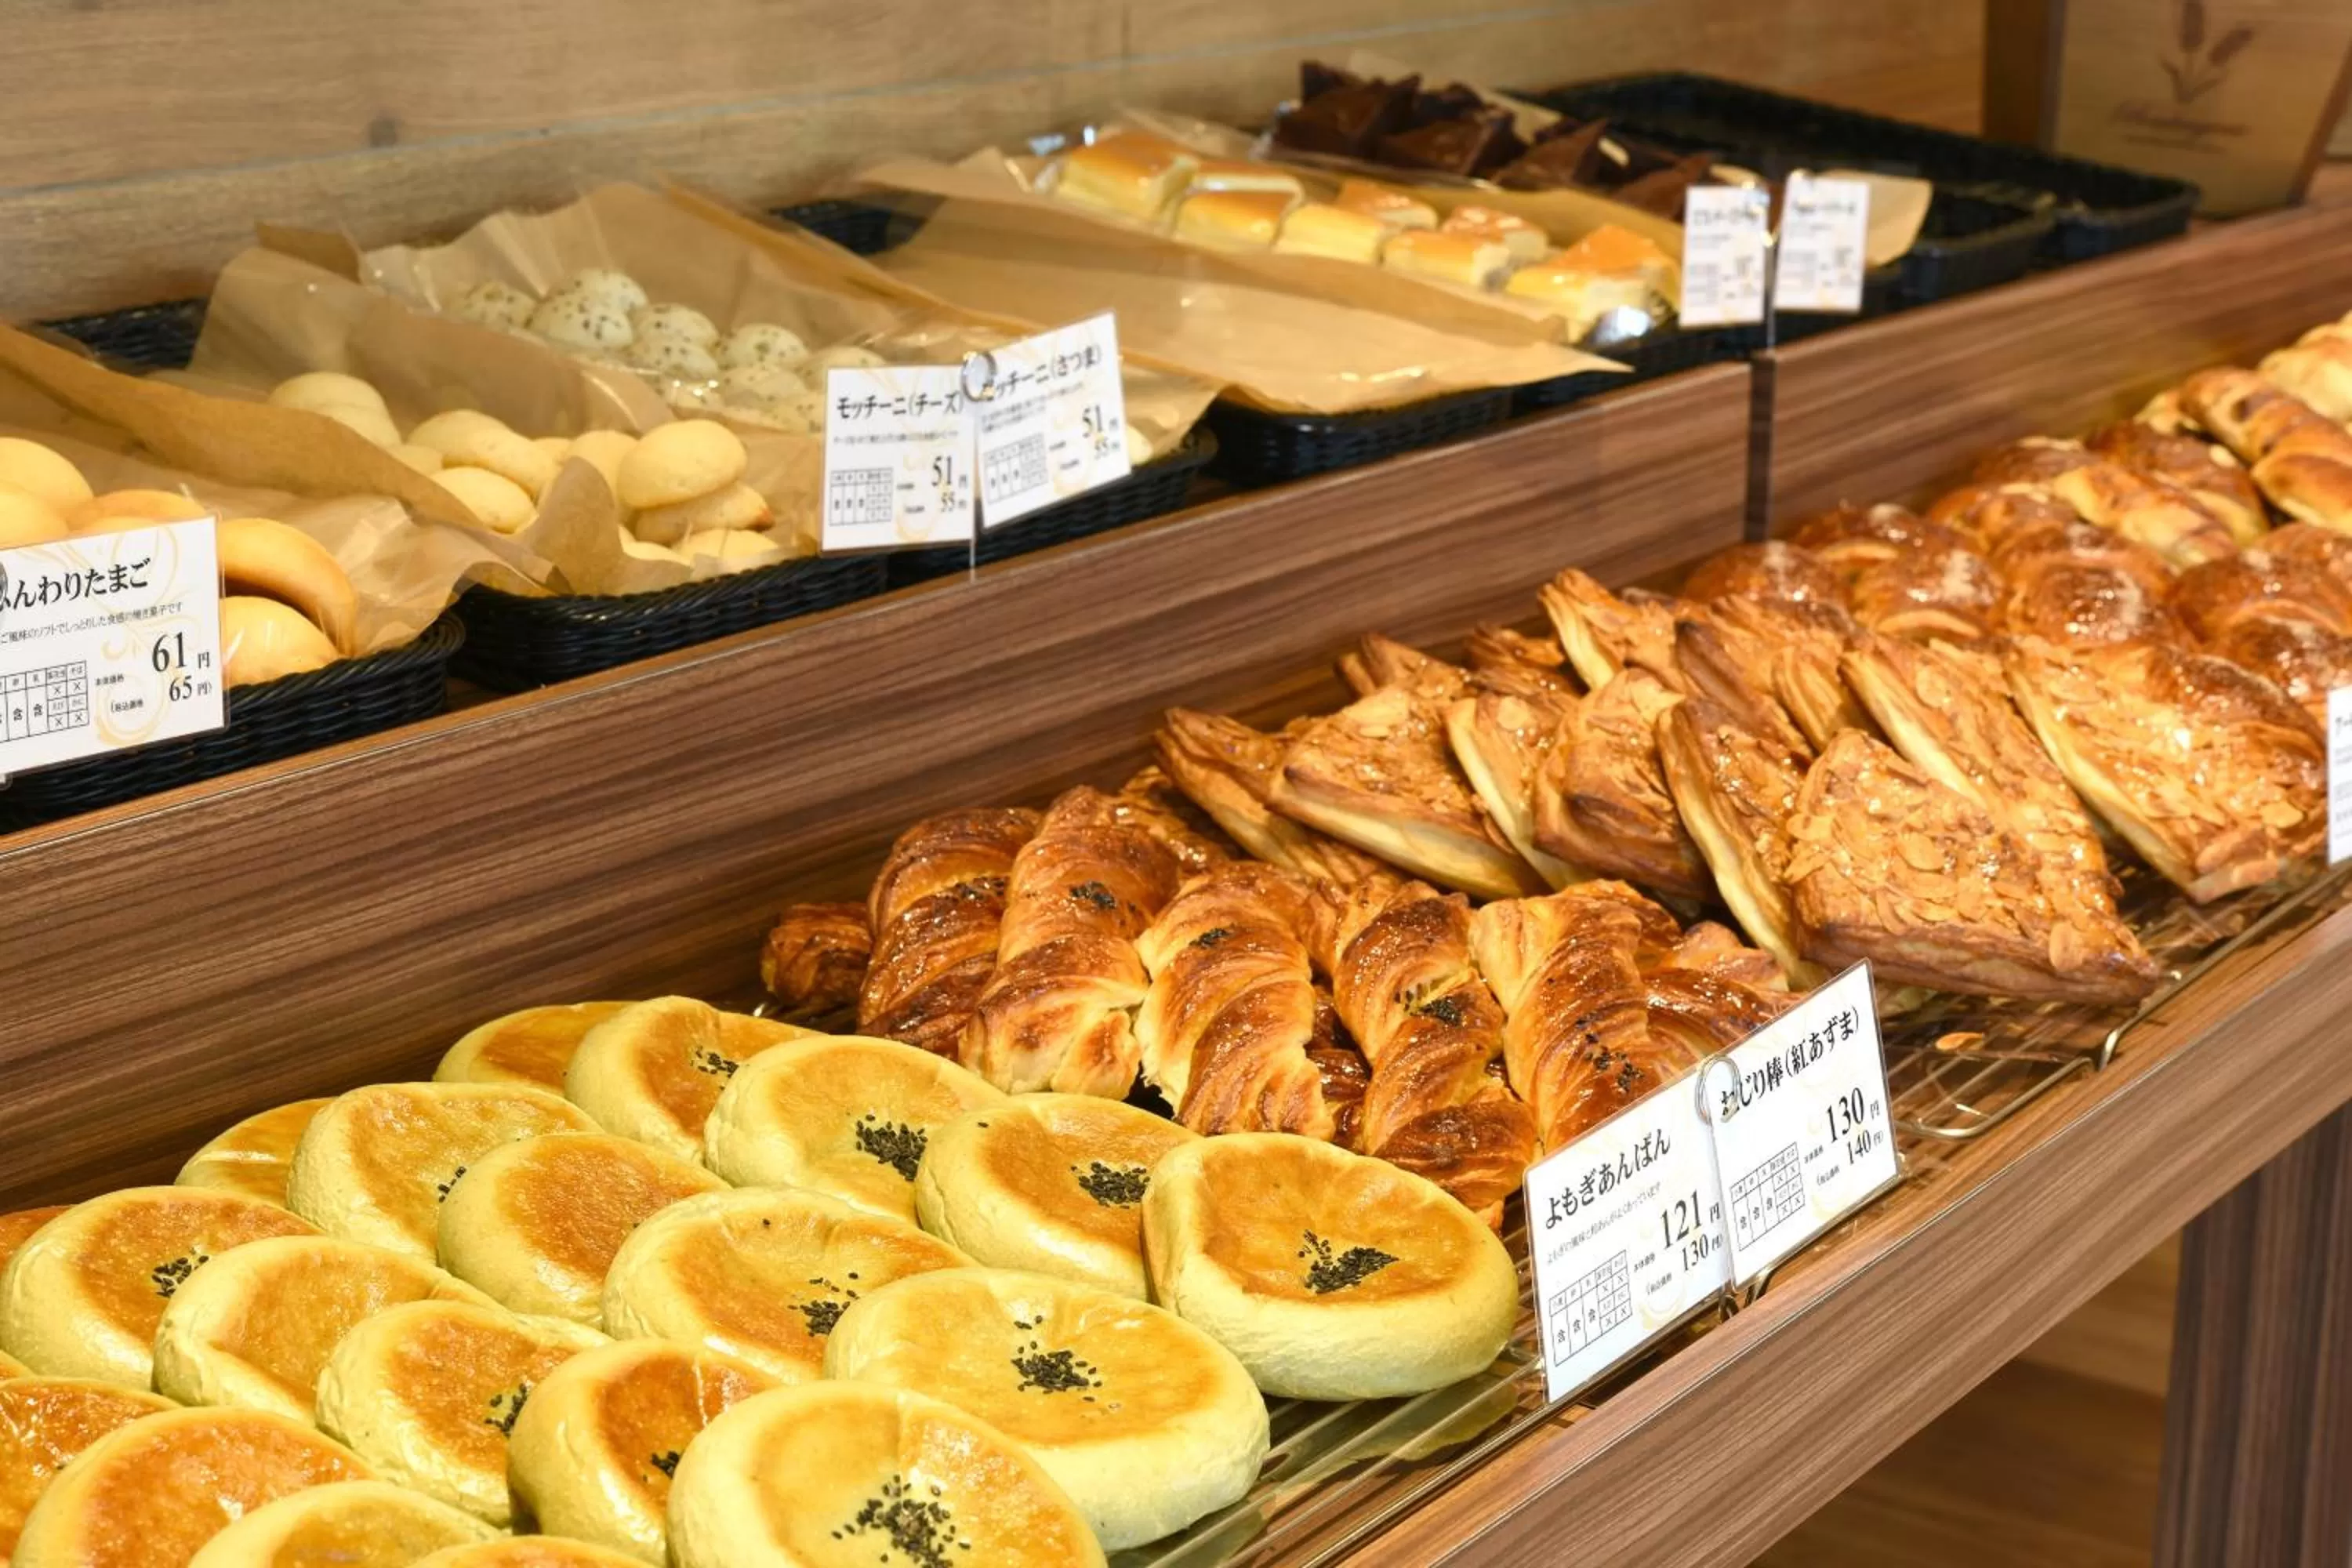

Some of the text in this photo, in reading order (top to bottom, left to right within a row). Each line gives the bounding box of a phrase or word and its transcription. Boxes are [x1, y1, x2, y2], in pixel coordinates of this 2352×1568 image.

[837, 391, 964, 419] モッチーニ(チーズ)
[1082, 405, 1103, 439] 51
[931, 456, 953, 487] 51
[152, 631, 187, 673] 61
[169, 675, 193, 702] 65
[1825, 1087, 1864, 1144] 130
[1846, 1129, 1871, 1166] 140
[1660, 1188, 1702, 1250] 121
[1682, 1233, 1708, 1272] 130
